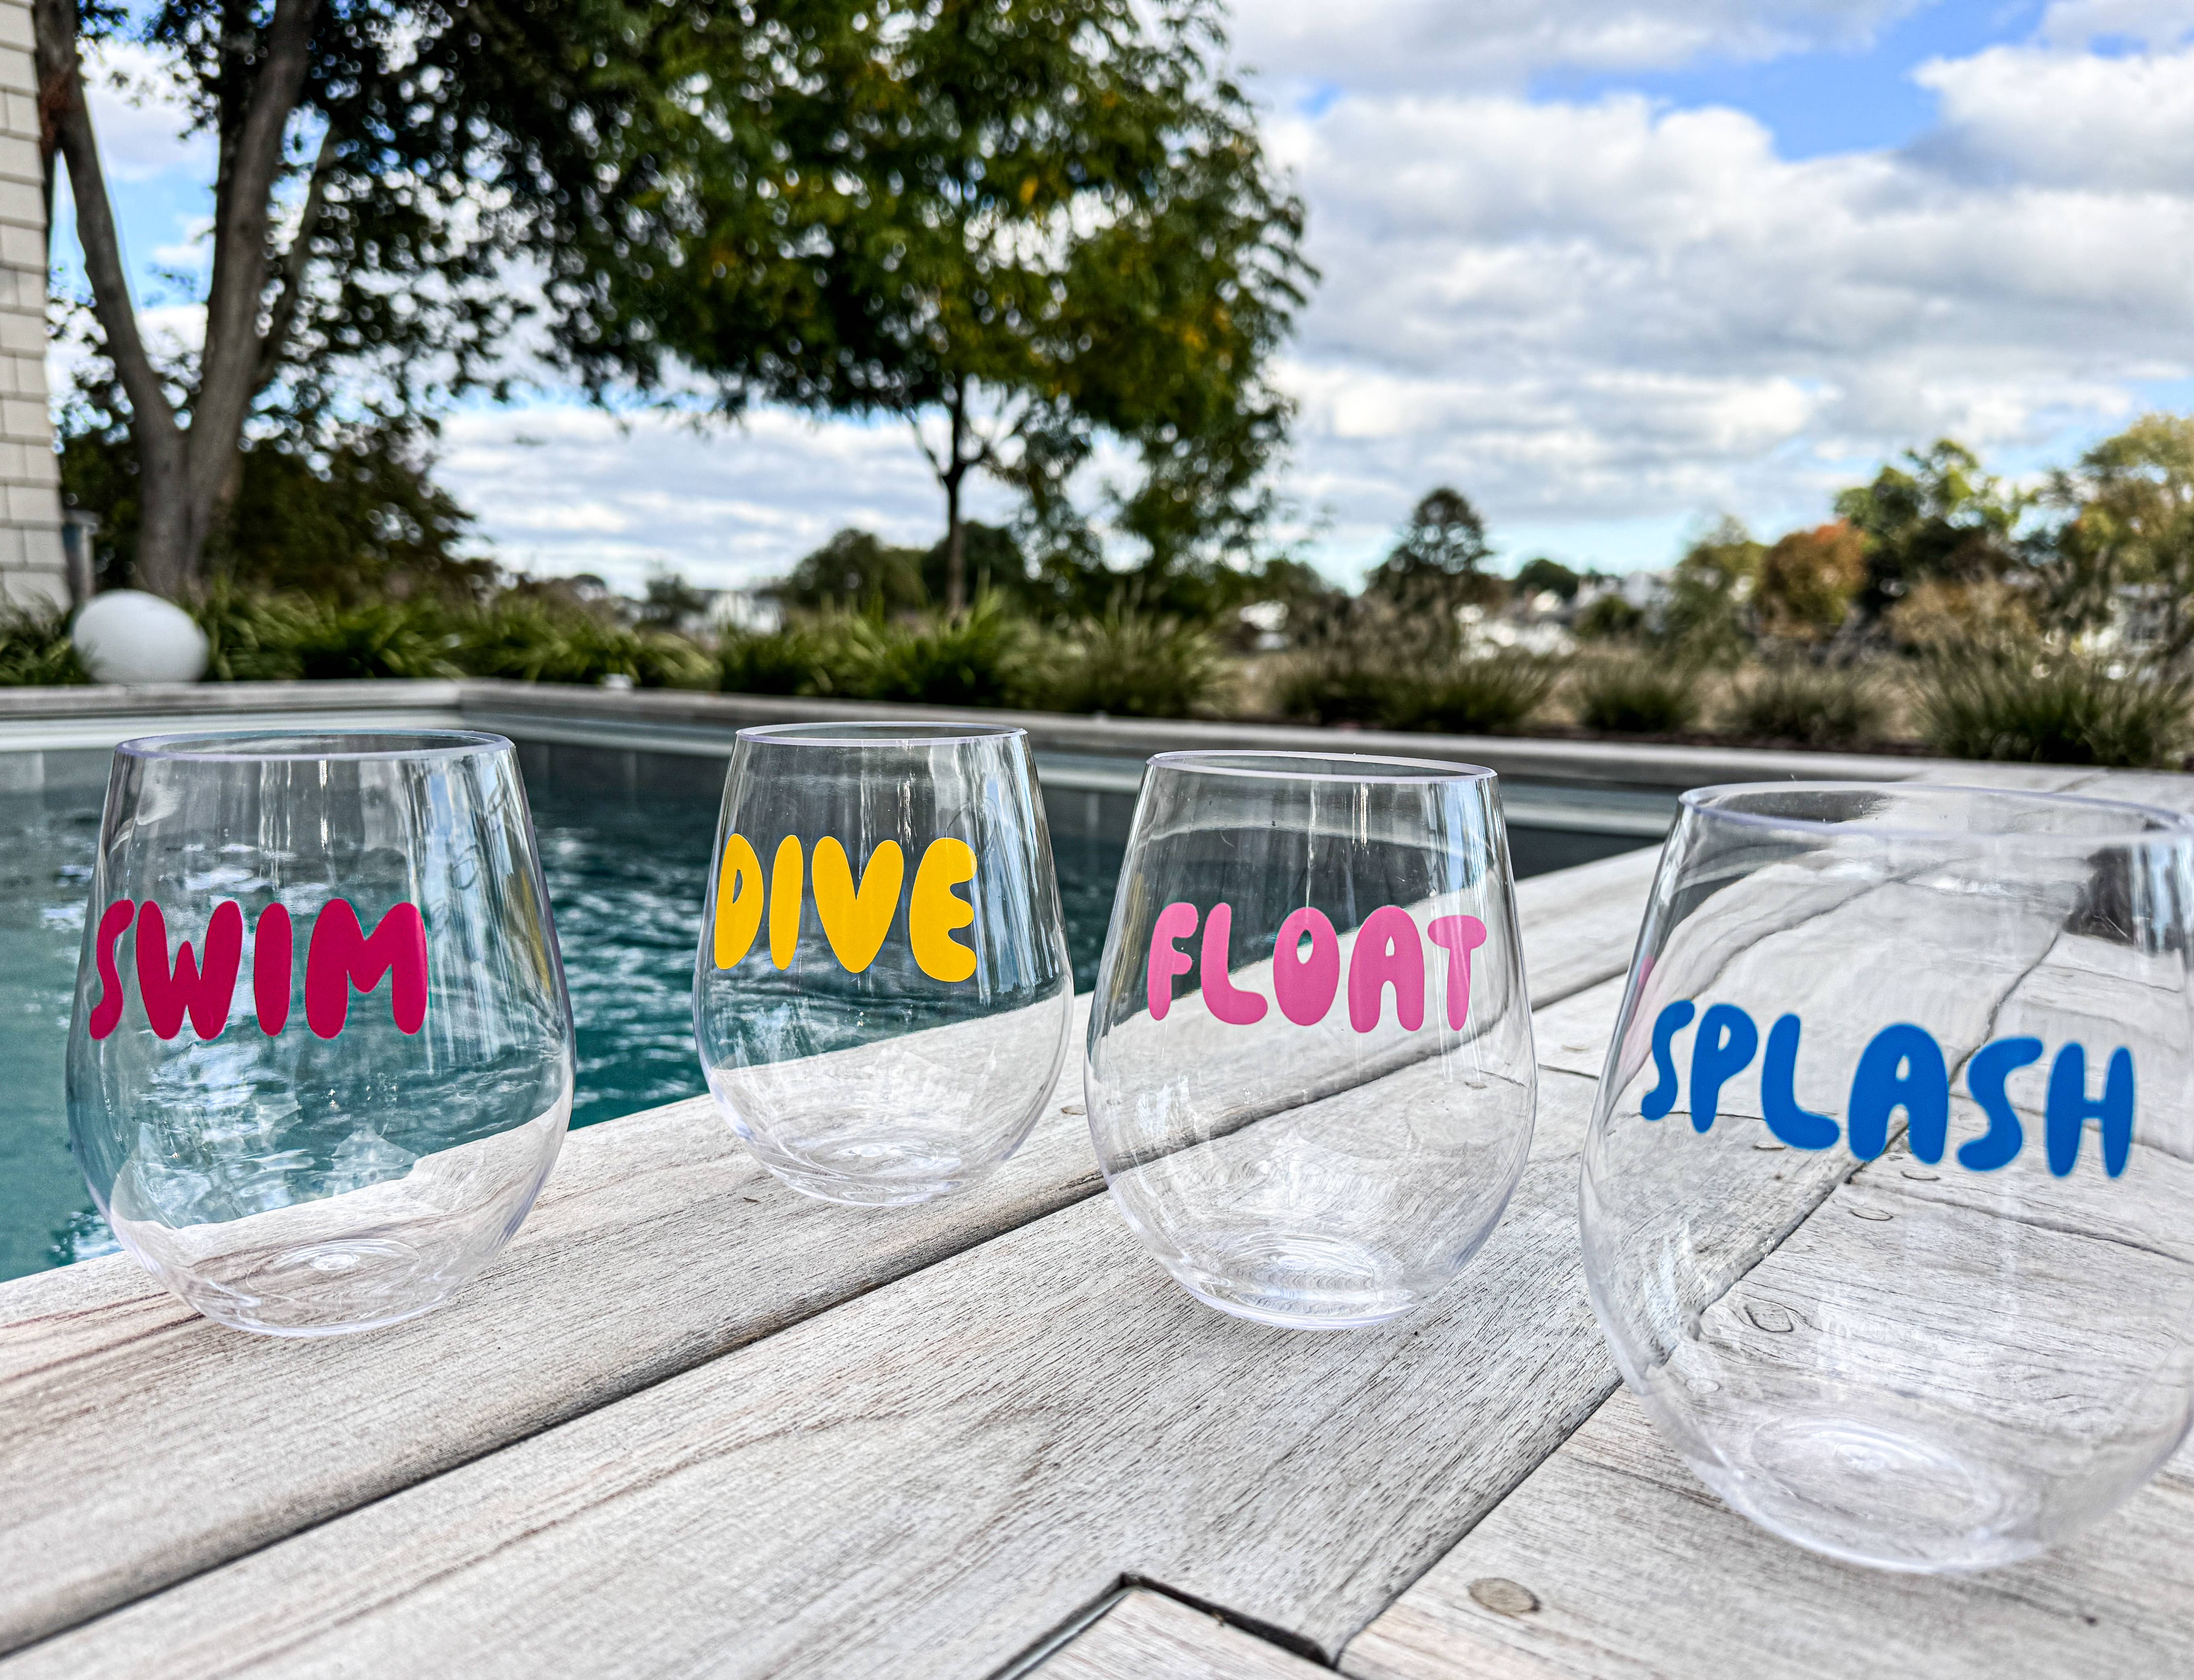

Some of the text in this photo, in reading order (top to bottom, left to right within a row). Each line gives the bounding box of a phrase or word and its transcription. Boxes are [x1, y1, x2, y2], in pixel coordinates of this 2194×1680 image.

[89, 898, 428, 1040] SWIM
[714, 834, 977, 982] DIVE
[1147, 902, 1487, 1033] FLOAT
[1640, 999, 2135, 1179] SPLASH
